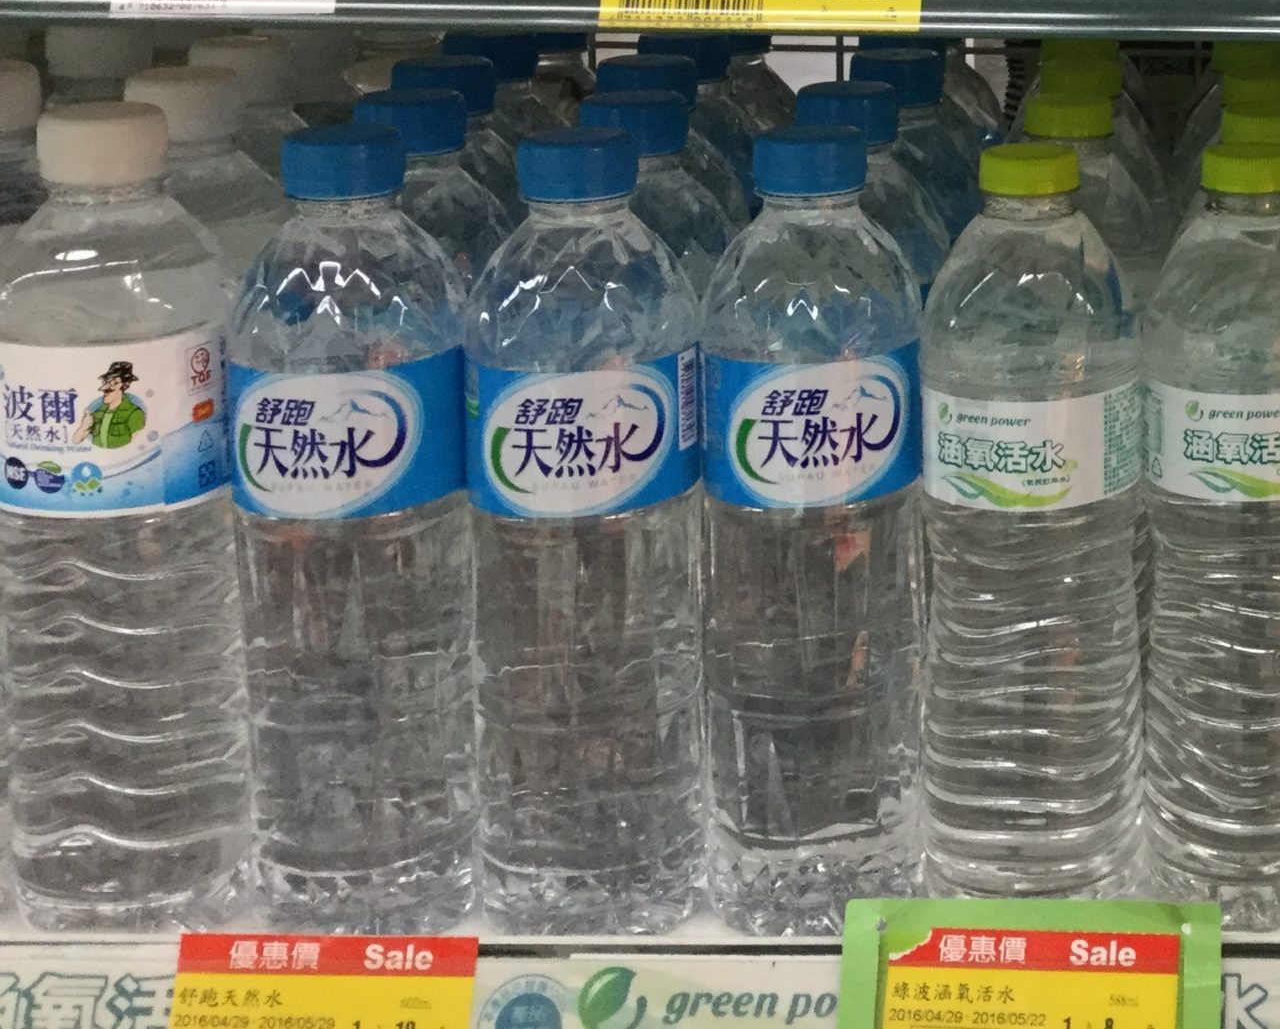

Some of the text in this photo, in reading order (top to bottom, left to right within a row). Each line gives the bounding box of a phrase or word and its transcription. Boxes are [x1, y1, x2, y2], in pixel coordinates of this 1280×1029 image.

[3, 383, 78, 424] 波爾
[256, 398, 315, 426] 舒跑
[515, 398, 583, 425] 舒跑
[761, 390, 828, 416] 舒跑
[1209, 409, 1243, 420] green
[956, 413, 1031, 427] green power
[254, 425, 378, 479] 天然水
[512, 422, 641, 478] 天然水
[758, 413, 879, 469] 天然水
[937, 431, 1066, 474] 涵氧活水
[229, 940, 433, 971] 優惠價 Sale
[939, 934, 1136, 968] 優惠價 Sale
[179, 987, 283, 1008] 舒跑天然水
[662, 991, 779, 1025] green
[889, 1008, 963, 1024] 2016/04/29
[972, 1011, 1046, 1027] 2016/05/22
